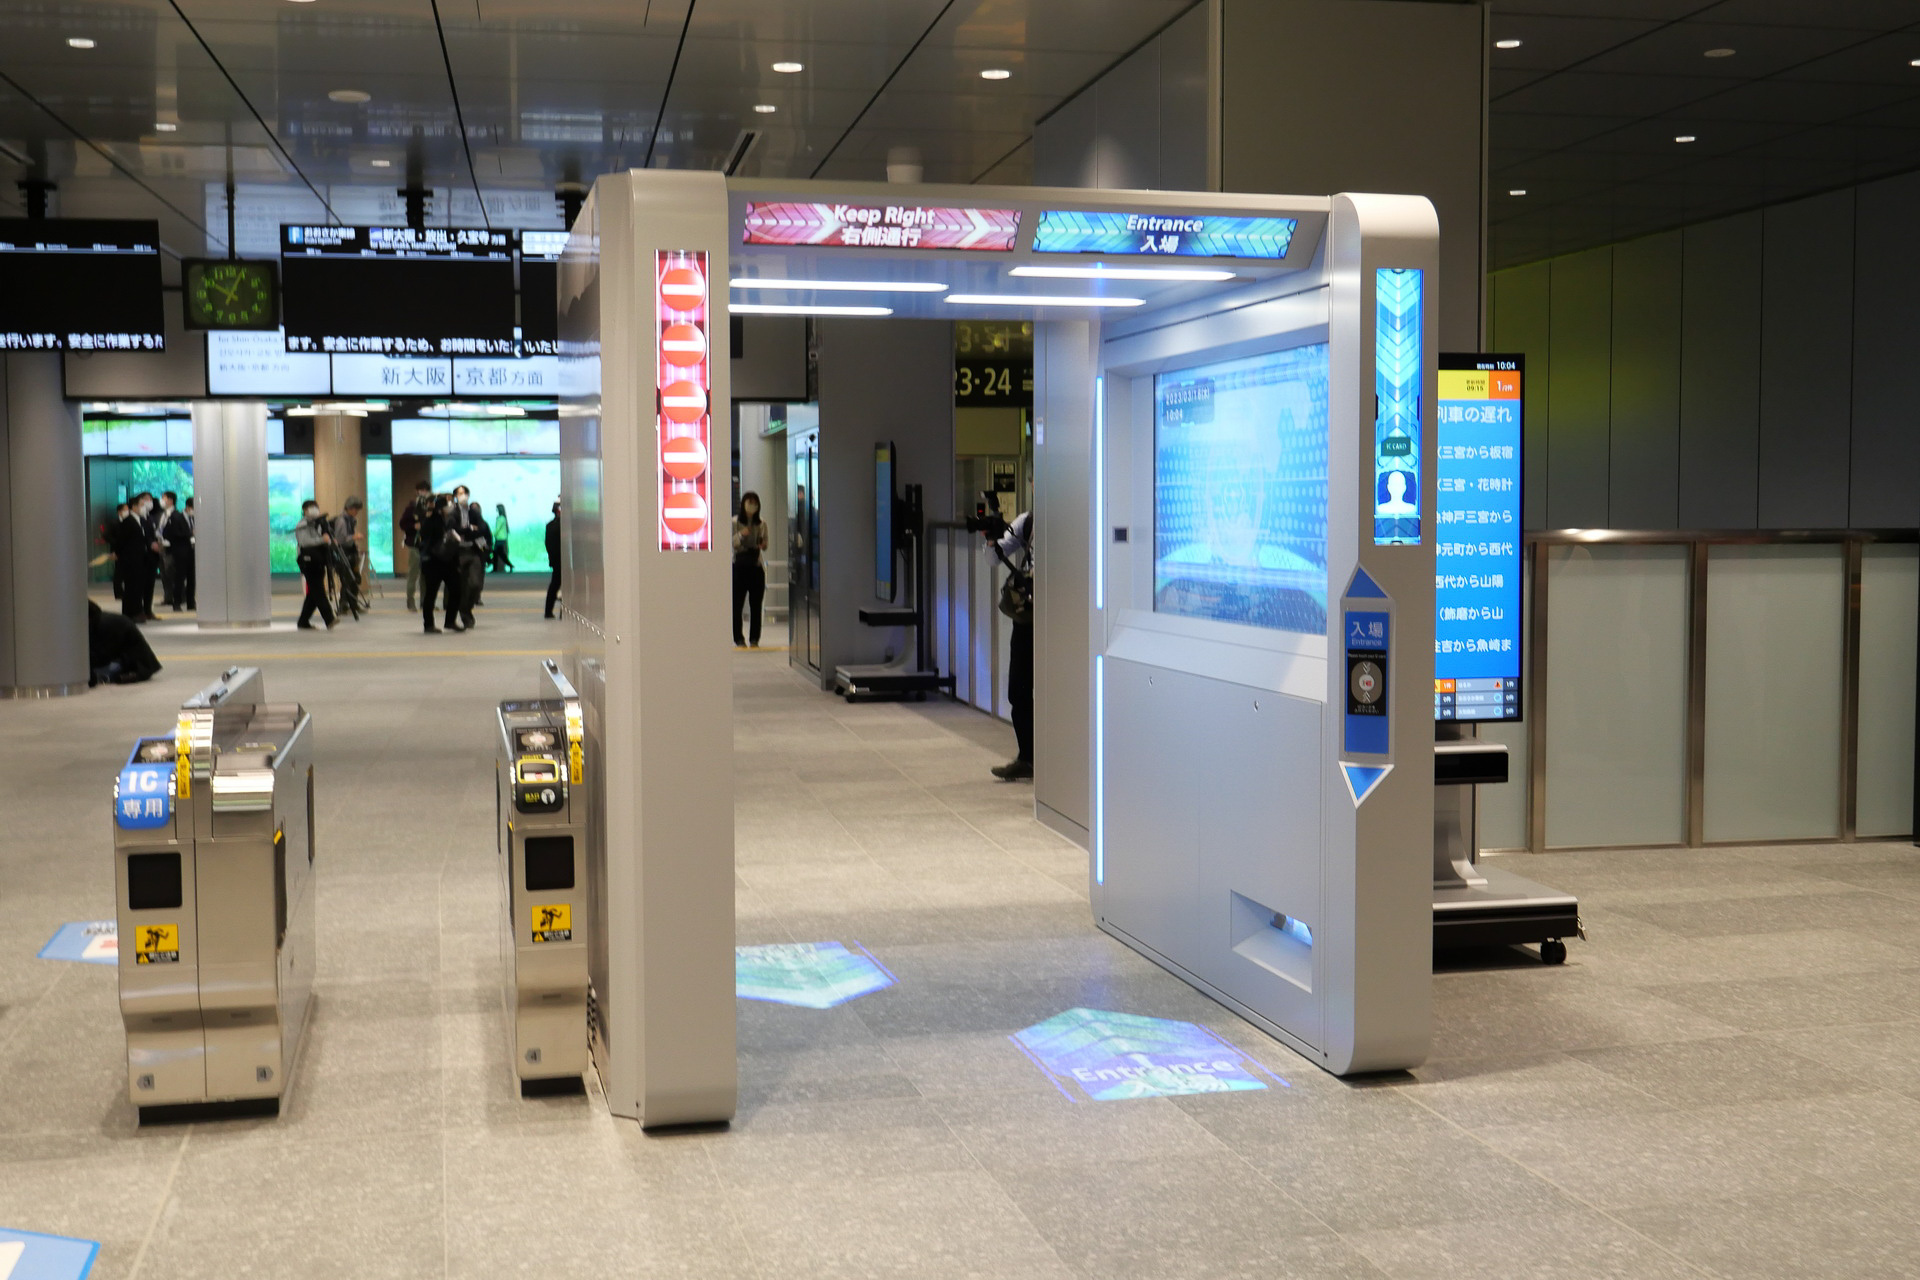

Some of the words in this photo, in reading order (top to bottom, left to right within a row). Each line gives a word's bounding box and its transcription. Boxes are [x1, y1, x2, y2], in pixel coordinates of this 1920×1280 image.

[834, 204, 882, 226] Keep
[885, 206, 935, 227] Right
[1127, 214, 1204, 233] Entrance
[841, 225, 921, 247] 右側通行
[1140, 234, 1180, 254] 入場
[1497, 361, 1516, 371] 10:04
[954, 367, 1012, 396] 3・24
[1350, 621, 1383, 638] 入場
[129, 770, 159, 793] IC
[123, 798, 163, 819] 専用
[1072, 1060, 1236, 1083] Entrance
